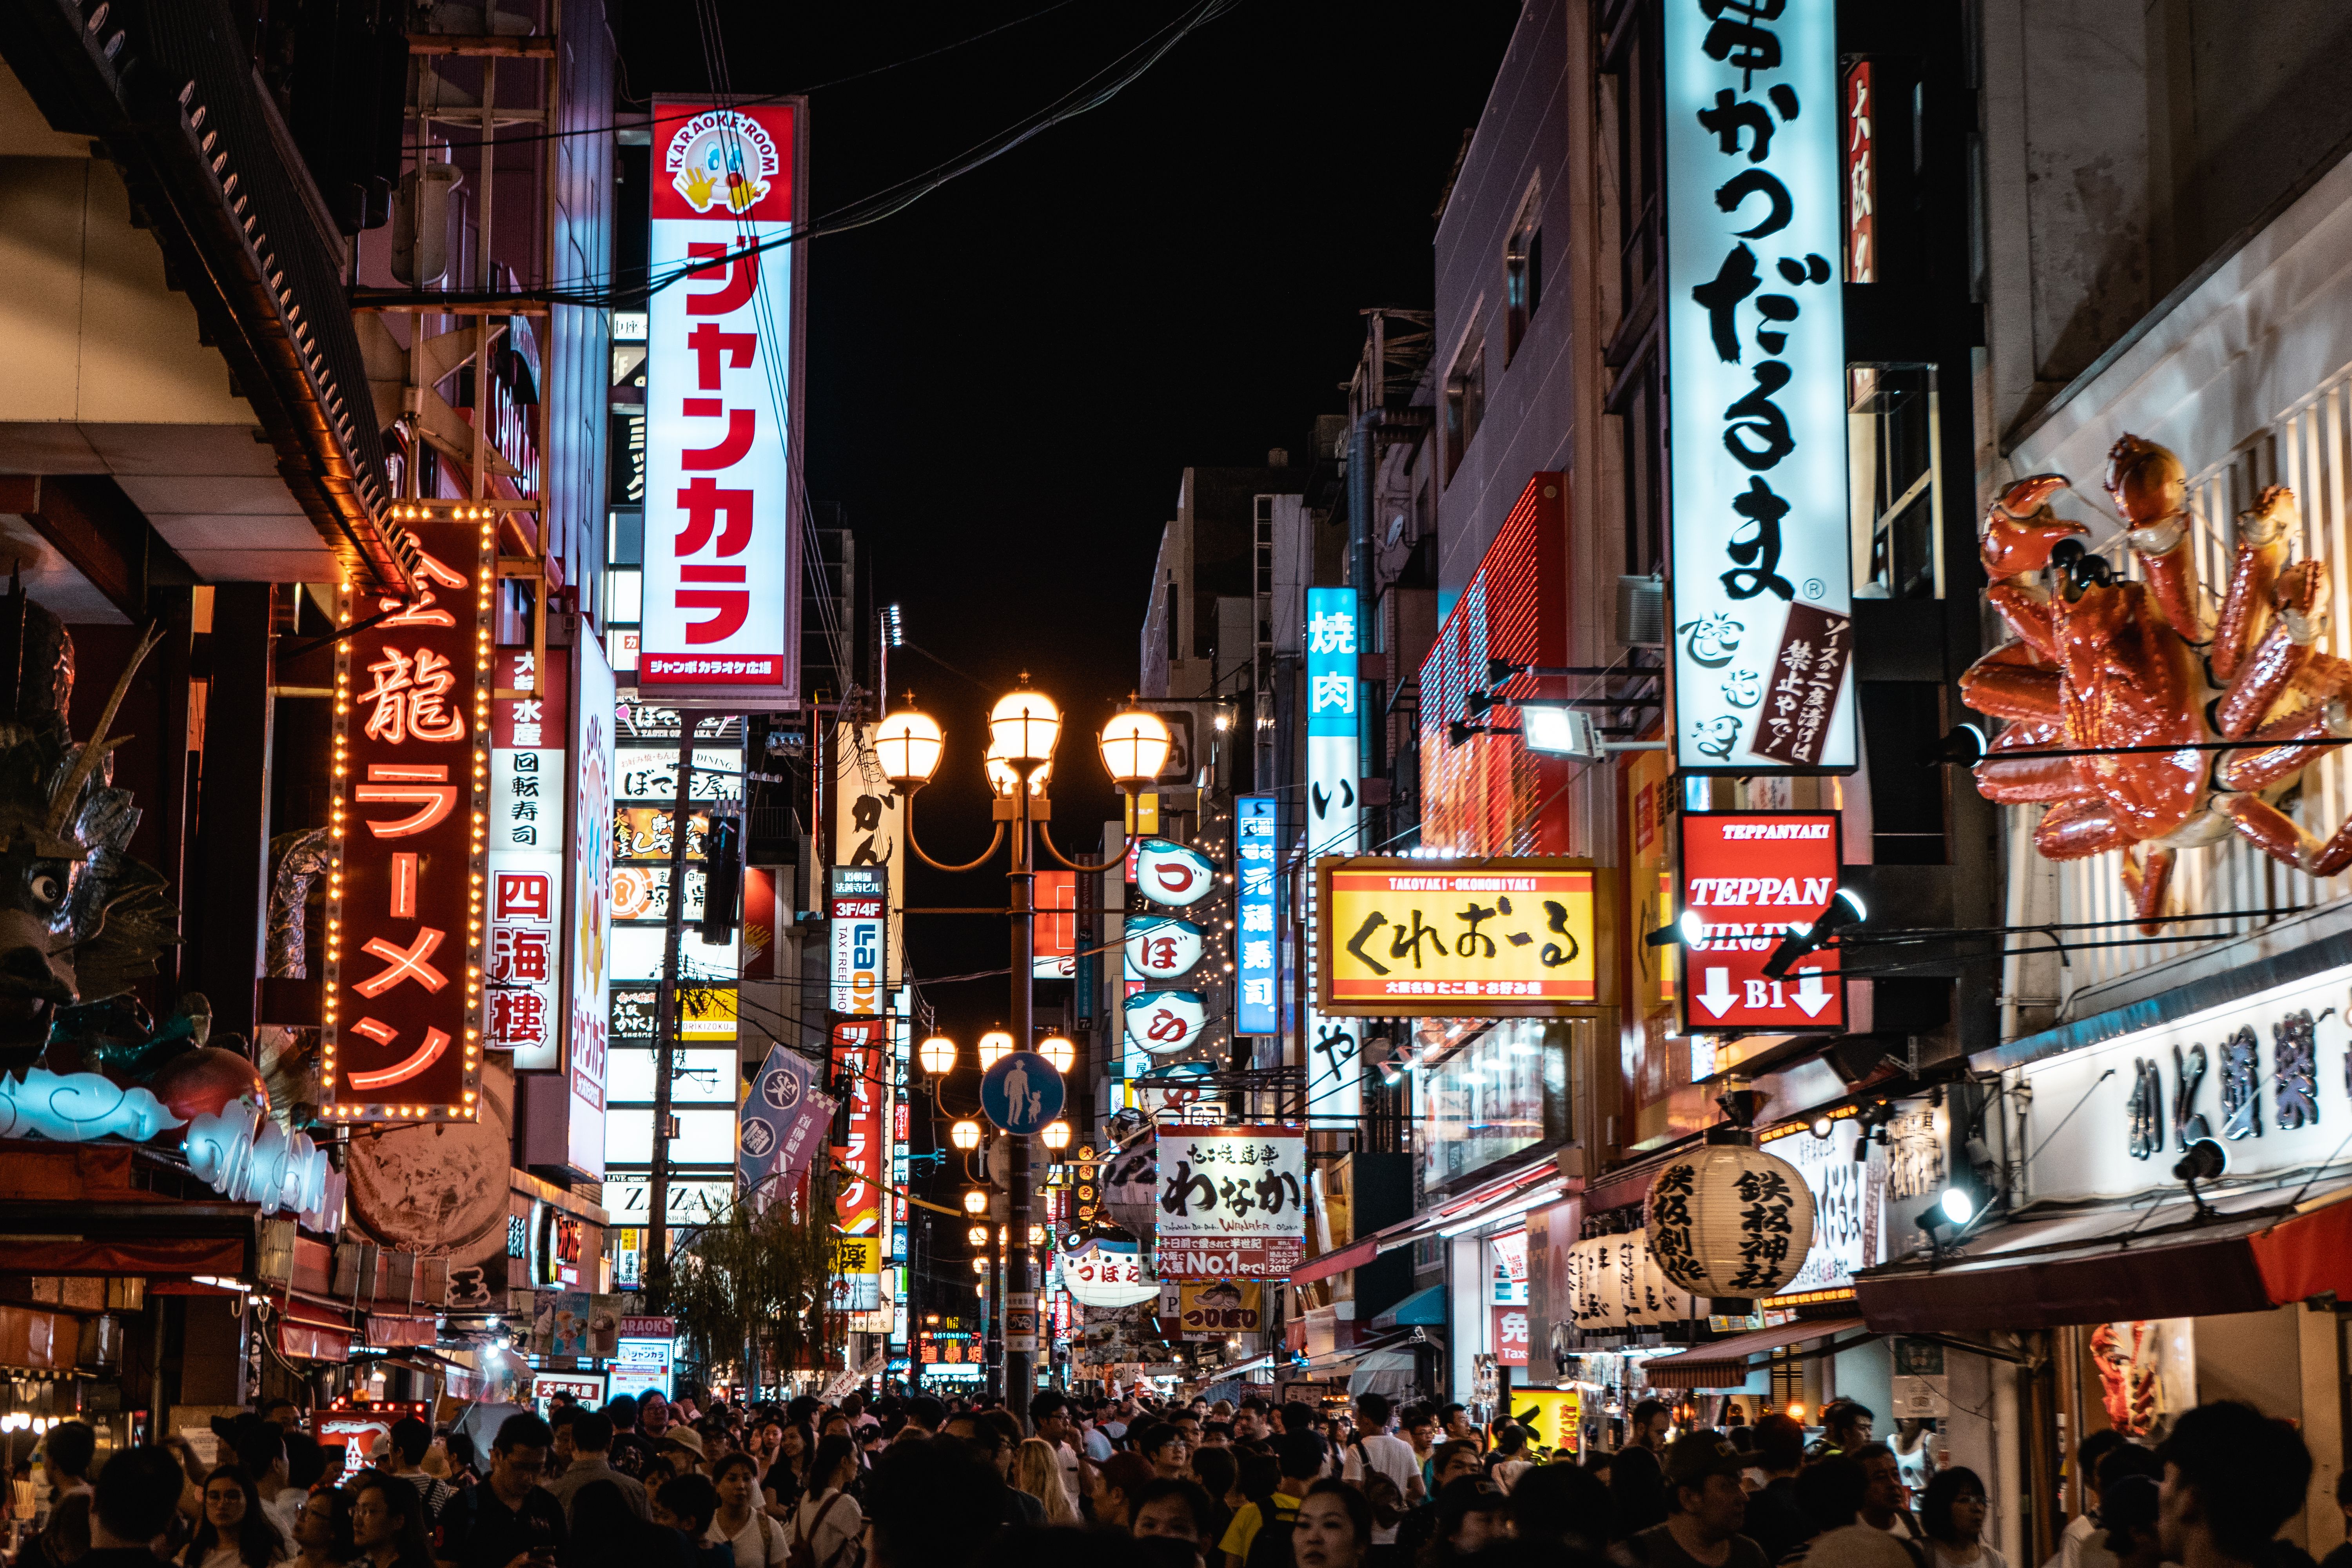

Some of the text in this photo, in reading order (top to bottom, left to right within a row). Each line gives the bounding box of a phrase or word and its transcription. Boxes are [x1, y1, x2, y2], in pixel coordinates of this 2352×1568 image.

[1310, 612, 1356, 714] 焼肉
[696, 753, 733, 770] DINING
[1722, 824, 1830, 840] TEPPANYAKI
[835, 883, 880, 893] 法善寺ビル
[1690, 877, 1833, 906] TEPPAN
[836, 903, 880, 916] 3F/4F
[839, 926, 847, 947] TAX
[838, 952, 847, 982] FREE
[1386, 982, 1434, 994] 大阪名物
[1744, 980, 1787, 1008] B1
[612, 1004, 641, 1017] 大阪
[624, 1187, 711, 1210] ZZA
[1161, 1160, 1301, 1218] わなか
[1730, 1170, 1794, 1290] 鉄板神社
[1186, 1251, 1239, 1275] No.1
[620, 1319, 669, 1332] ARAOKE
[868, 1319, 886, 1328] 和食
[1502, 1348, 1528, 1359] Tax-
